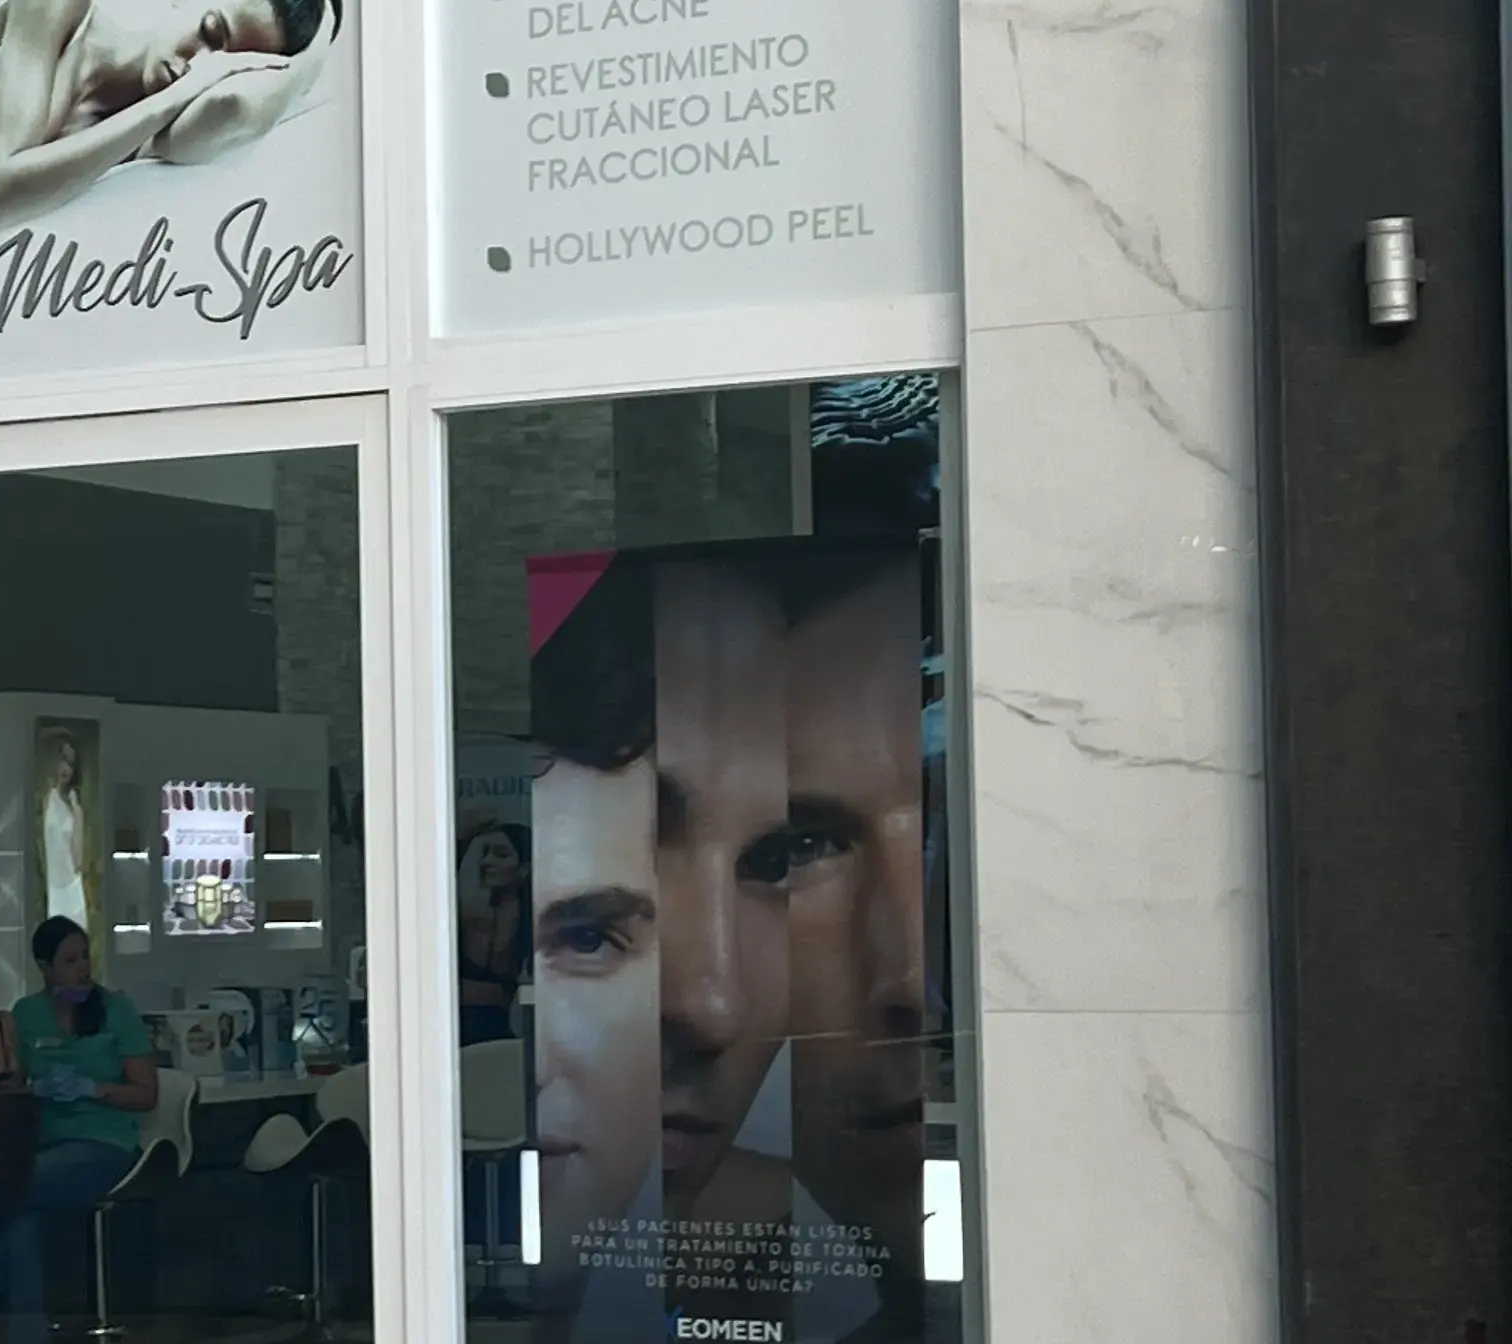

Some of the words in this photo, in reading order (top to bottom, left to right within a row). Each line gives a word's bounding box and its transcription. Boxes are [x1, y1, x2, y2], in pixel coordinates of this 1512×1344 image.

[529, 2, 593, 40] DEL
[527, 33, 809, 99] REVESTIMIENTO
[527, 95, 710, 145] CUTÁNEO
[724, 80, 836, 124] LASER
[529, 135, 780, 192] FRACCIONAL
[529, 214, 773, 269] HOLLYWOOD
[789, 204, 873, 243] PEEL
[571, 1234, 618, 1250] PARA
[624, 1237, 649, 1251] UN
[657, 1238, 783, 1256] TRATAMIENTO
[790, 1242, 814, 1258] DE
[823, 1242, 892, 1260] TOXINA
[637, 1220, 736, 1237] PACIENTES
[809, 1223, 873, 1241] LISTOS
[644, 1272, 668, 1288] DE
[676, 1274, 739, 1291] FORMA
[694, 1256, 737, 1273] TIPO
[768, 1259, 884, 1279] PURIFICADO
